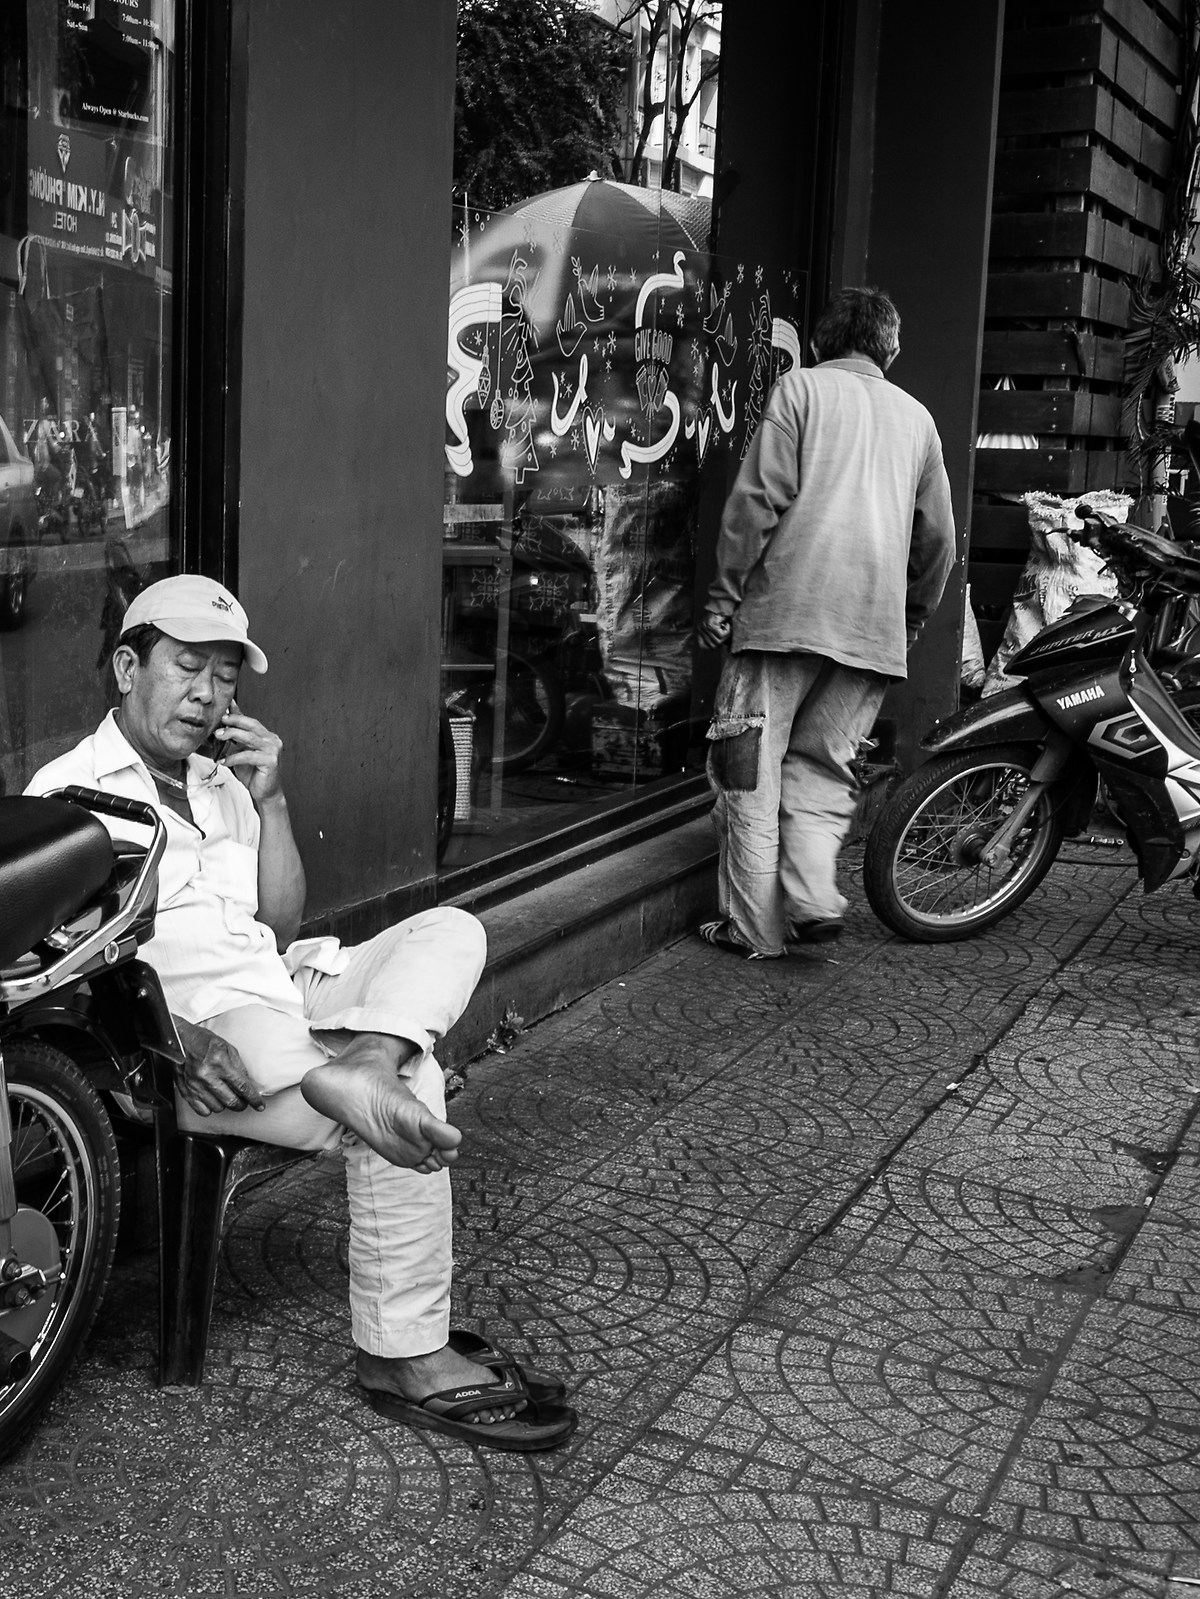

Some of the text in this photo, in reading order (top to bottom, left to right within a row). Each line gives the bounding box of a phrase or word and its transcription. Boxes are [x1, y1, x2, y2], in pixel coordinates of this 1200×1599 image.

[81, 102, 98, 114] Always
[99, 105, 112, 116] Open
[635, 328, 673, 365] GIVE GOOD
[1056, 685, 1105, 710] YAMAHA
[455, 1389, 481, 1398] ADDA
